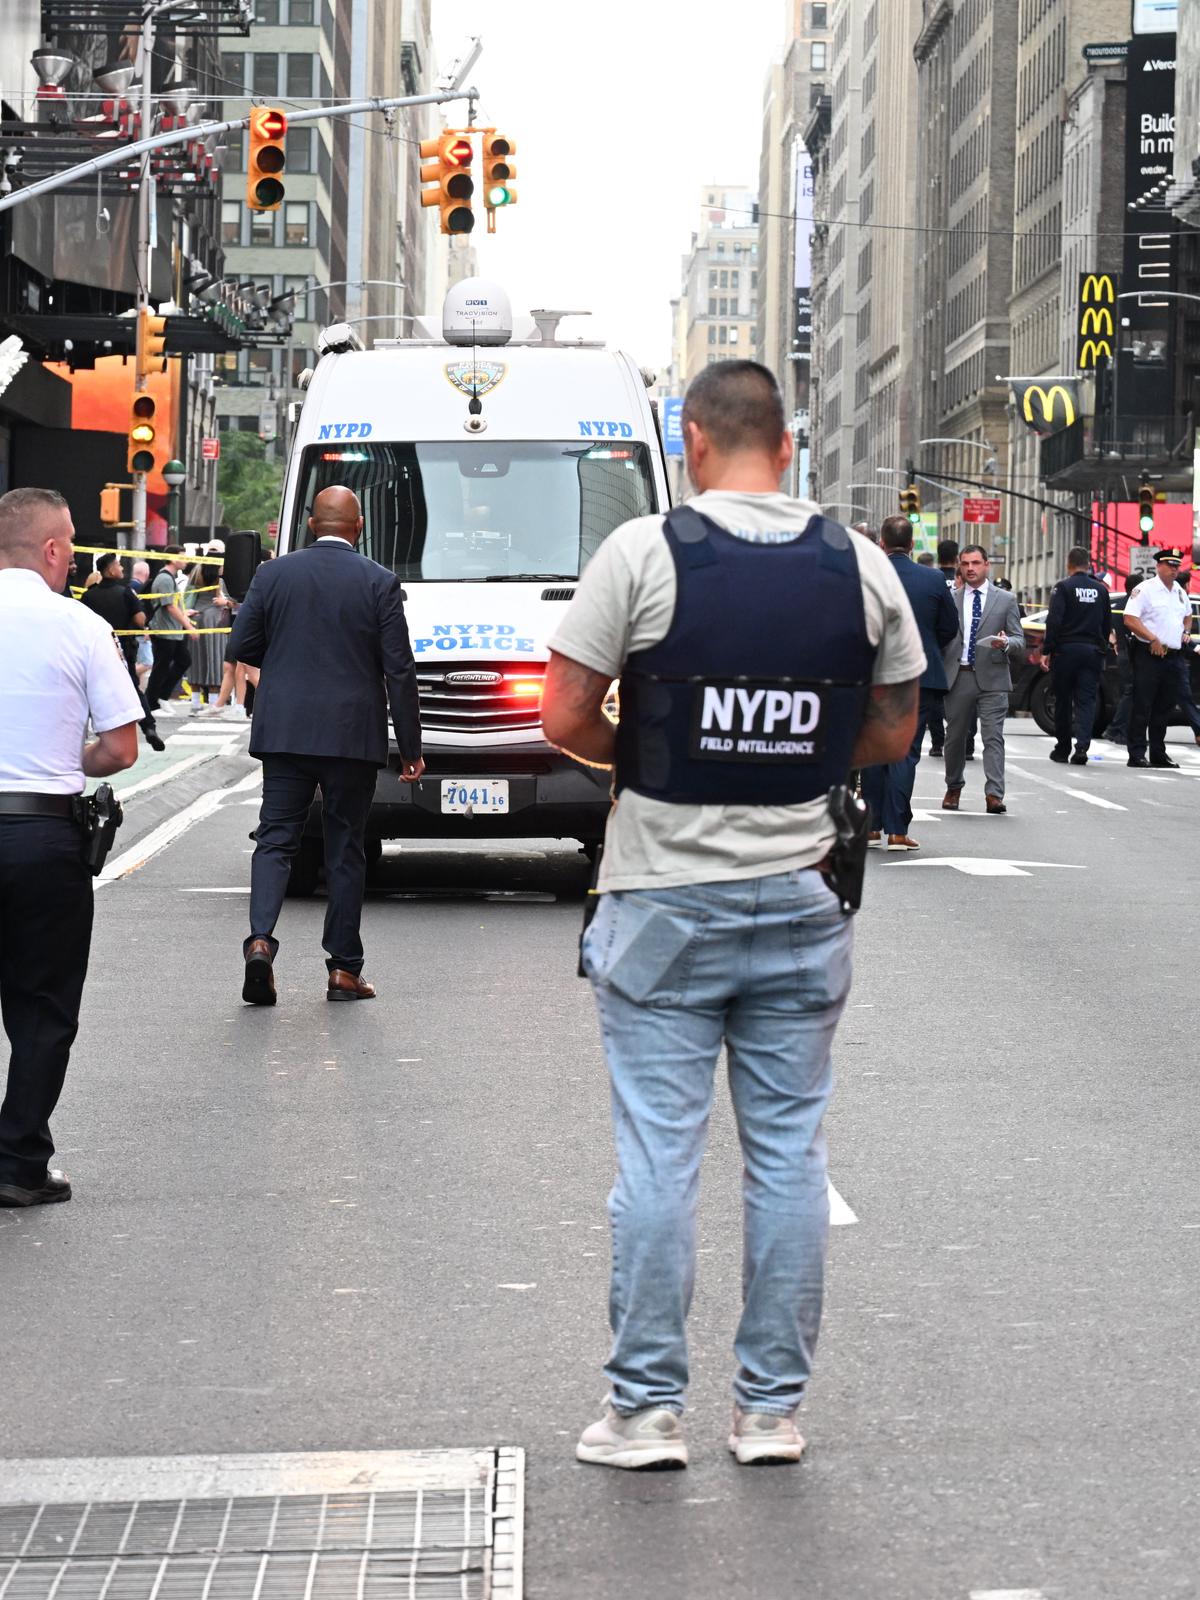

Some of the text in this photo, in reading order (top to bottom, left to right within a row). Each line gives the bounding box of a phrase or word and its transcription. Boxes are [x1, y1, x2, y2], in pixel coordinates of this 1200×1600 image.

[1140, 135, 1155, 154] in
[318, 422, 373, 440] NYPD
[578, 420, 633, 438] NYPD
[1134, 567, 1157, 580] 25
[1075, 588, 1098, 598] NYPD
[432, 624, 516, 636] NYPD
[414, 636, 535, 653] POLICE
[701, 686, 821, 735] NYPD
[700, 736, 815, 755] FIELD INTELLIGENCE
[447, 787, 504, 805] 7041 16
